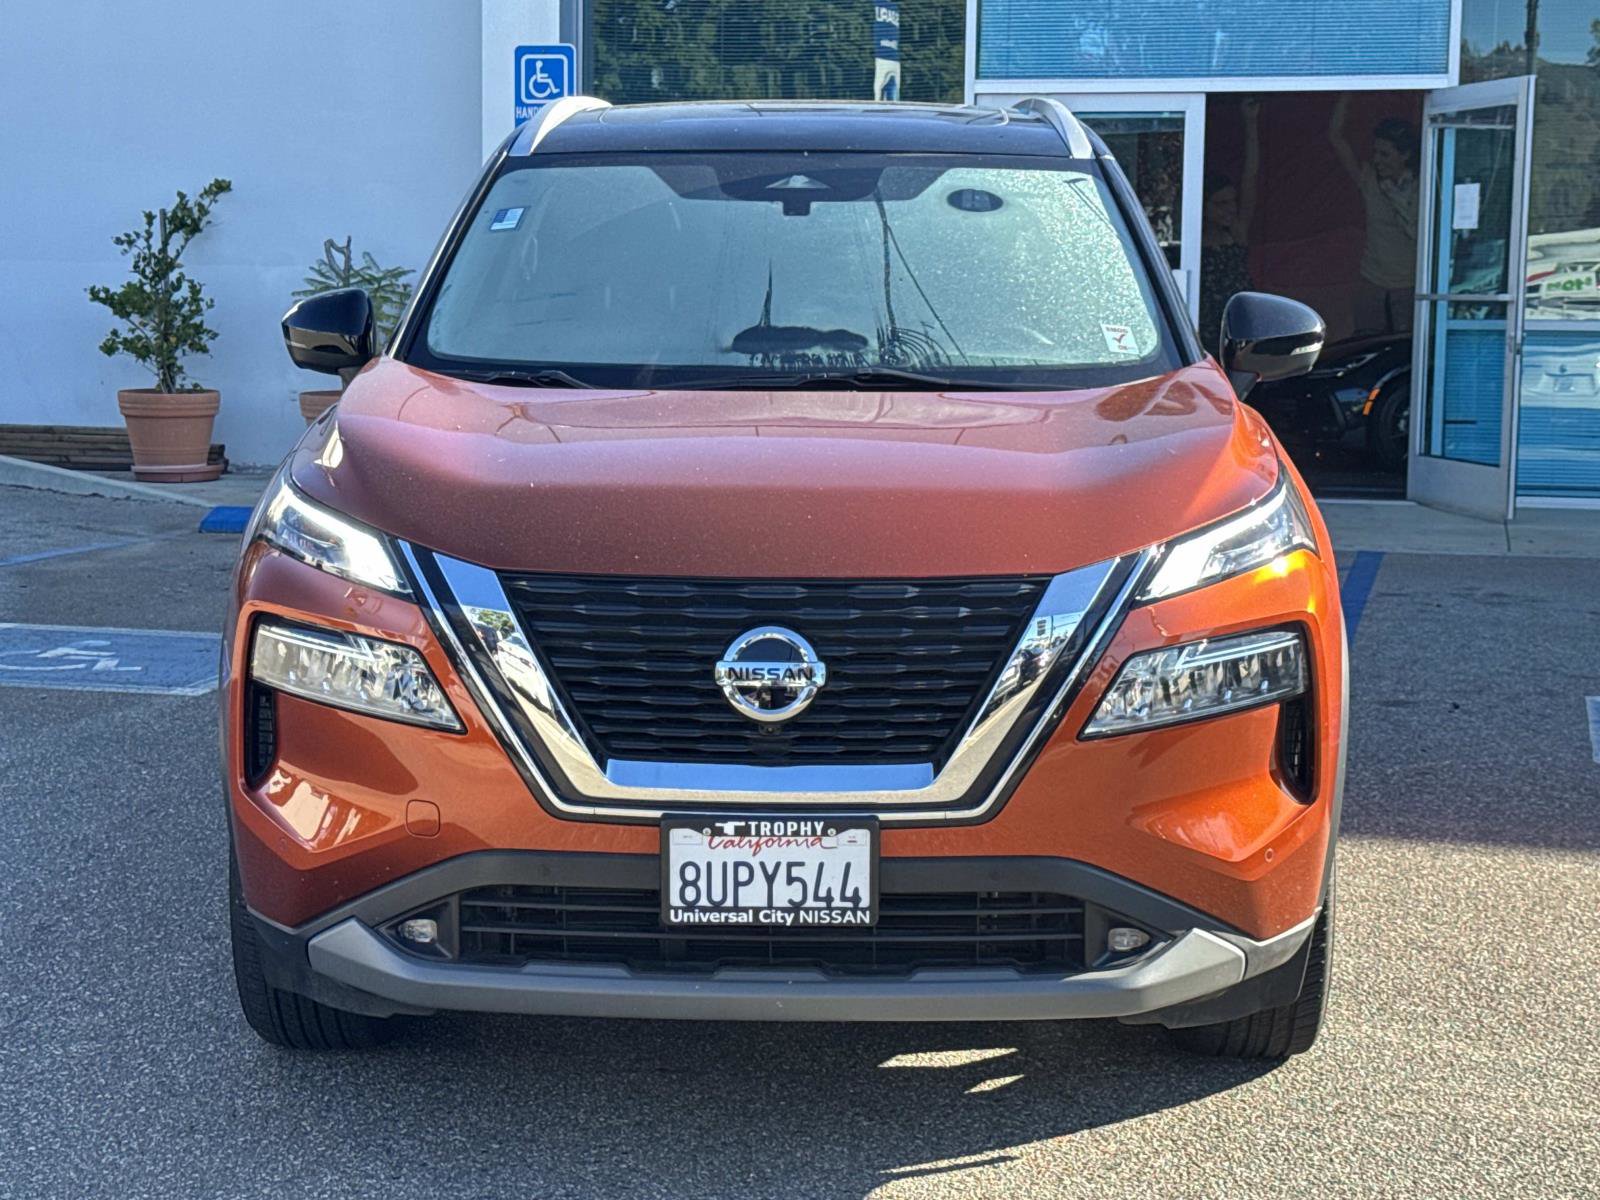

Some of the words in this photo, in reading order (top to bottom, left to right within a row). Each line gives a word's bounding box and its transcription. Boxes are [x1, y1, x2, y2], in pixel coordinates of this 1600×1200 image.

[728, 667, 813, 681] NISSAN
[748, 821, 824, 836] TROPHY
[707, 835, 838, 857] California
[679, 860, 863, 908] 8UPY544
[669, 909, 753, 924] Universal
[758, 909, 795, 926] City
[799, 910, 870, 924] NISSAN
